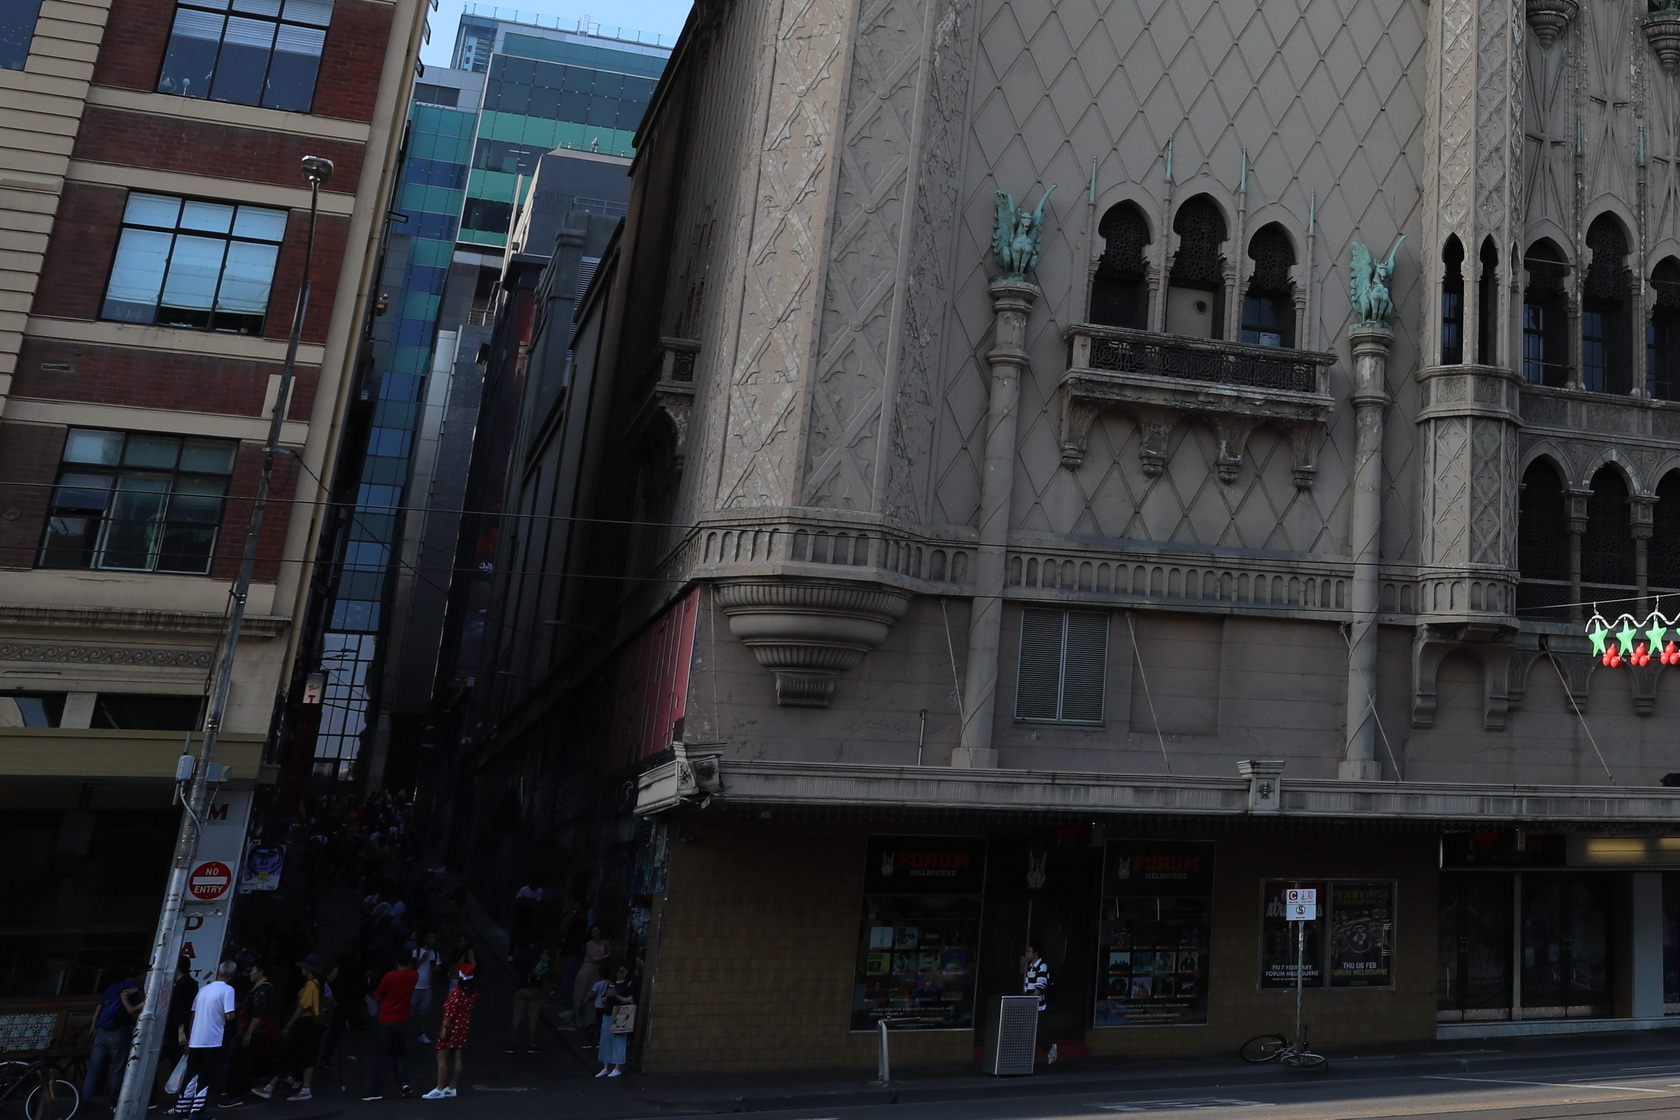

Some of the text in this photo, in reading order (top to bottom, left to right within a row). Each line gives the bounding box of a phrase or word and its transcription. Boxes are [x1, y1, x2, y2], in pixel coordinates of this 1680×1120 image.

[896, 851, 972, 869] FORUM
[1133, 856, 1200, 872] FORUM
[205, 867, 220, 876] NO
[909, 868, 958, 877] MELBOURNE
[1144, 871, 1188, 880] MELBOURNE
[194, 885, 224, 894] ENTRY
[1332, 888, 1391, 898] PENNYWISE
[1289, 891, 1298, 901] C
